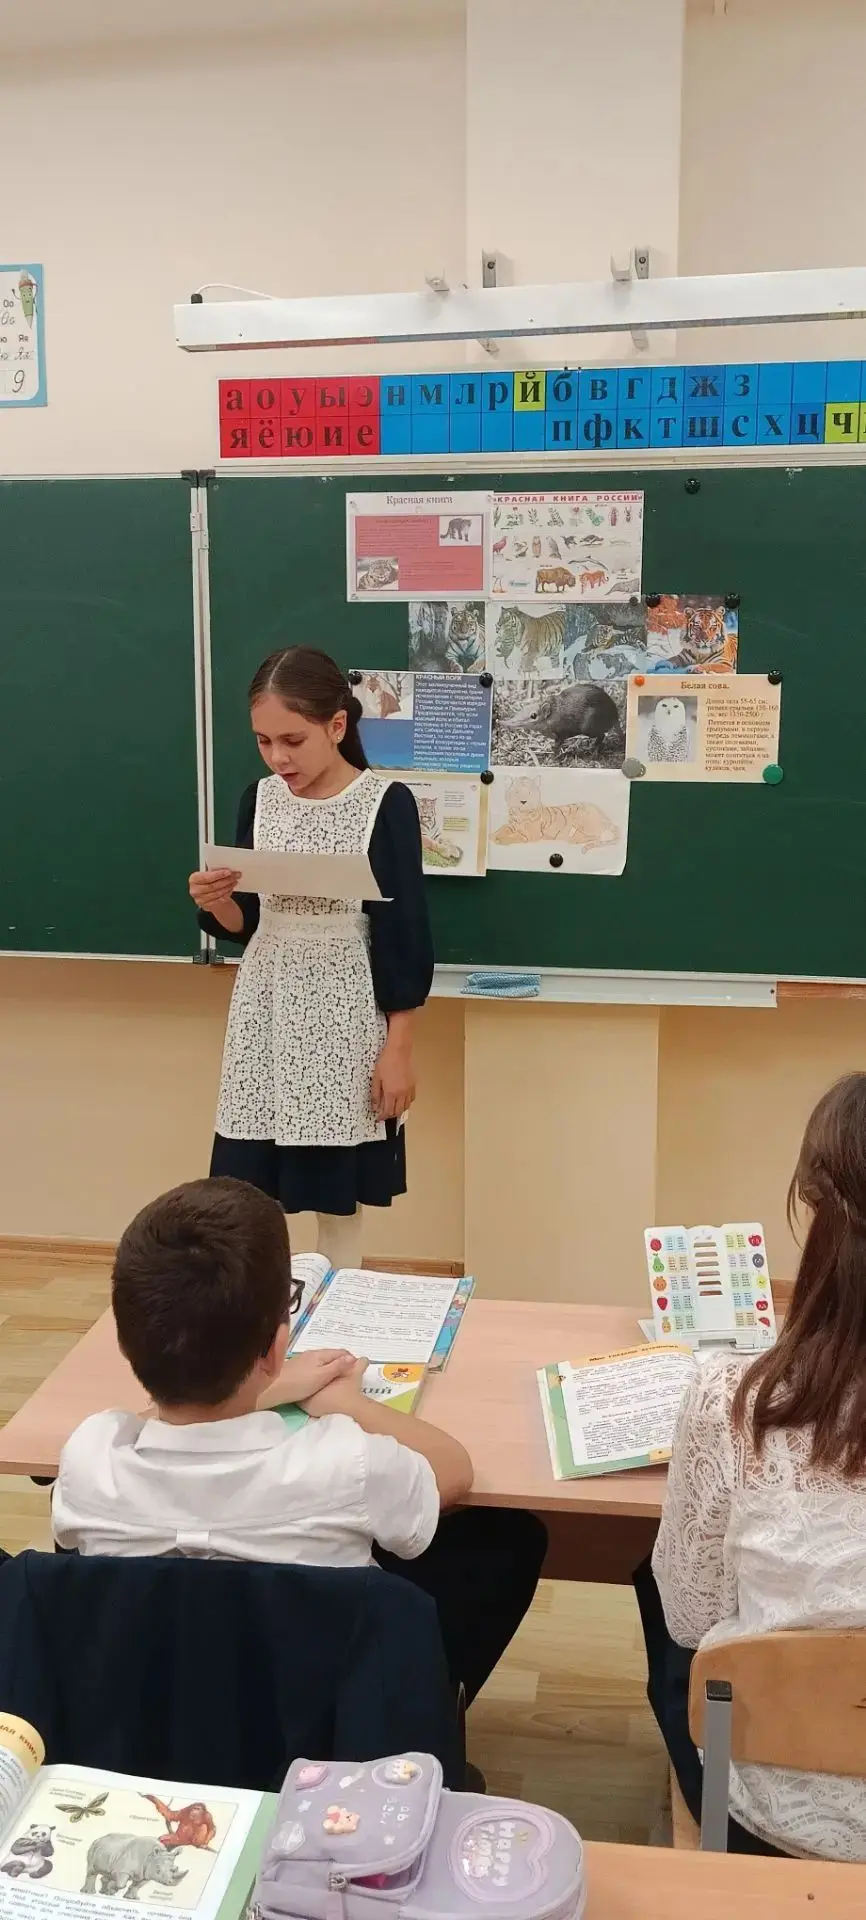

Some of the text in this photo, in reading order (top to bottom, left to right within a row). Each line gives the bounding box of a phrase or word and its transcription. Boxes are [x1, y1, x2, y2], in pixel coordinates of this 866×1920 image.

[12, 370, 25, 393] 9
[227, 370, 750, 415] а о у ы э н м л р й б в г д ж з
[230, 427, 248, 448] я
[258, 419, 274, 448] ё
[285, 426, 313, 448] ю
[324, 426, 344, 446] и
[357, 424, 373, 446] е
[552, 420, 572, 441] п
[584, 413, 612, 447] ф
[624, 418, 644, 440] к
[657, 418, 676, 438] т
[688, 416, 720, 438] ш
[732, 415, 749, 437] с
[764, 414, 785, 436] х
[797, 413, 819, 440] ц
[832, 413, 854, 434] ч
[386, 496, 424, 507] Красная
[680, 681, 706, 689] Белая
